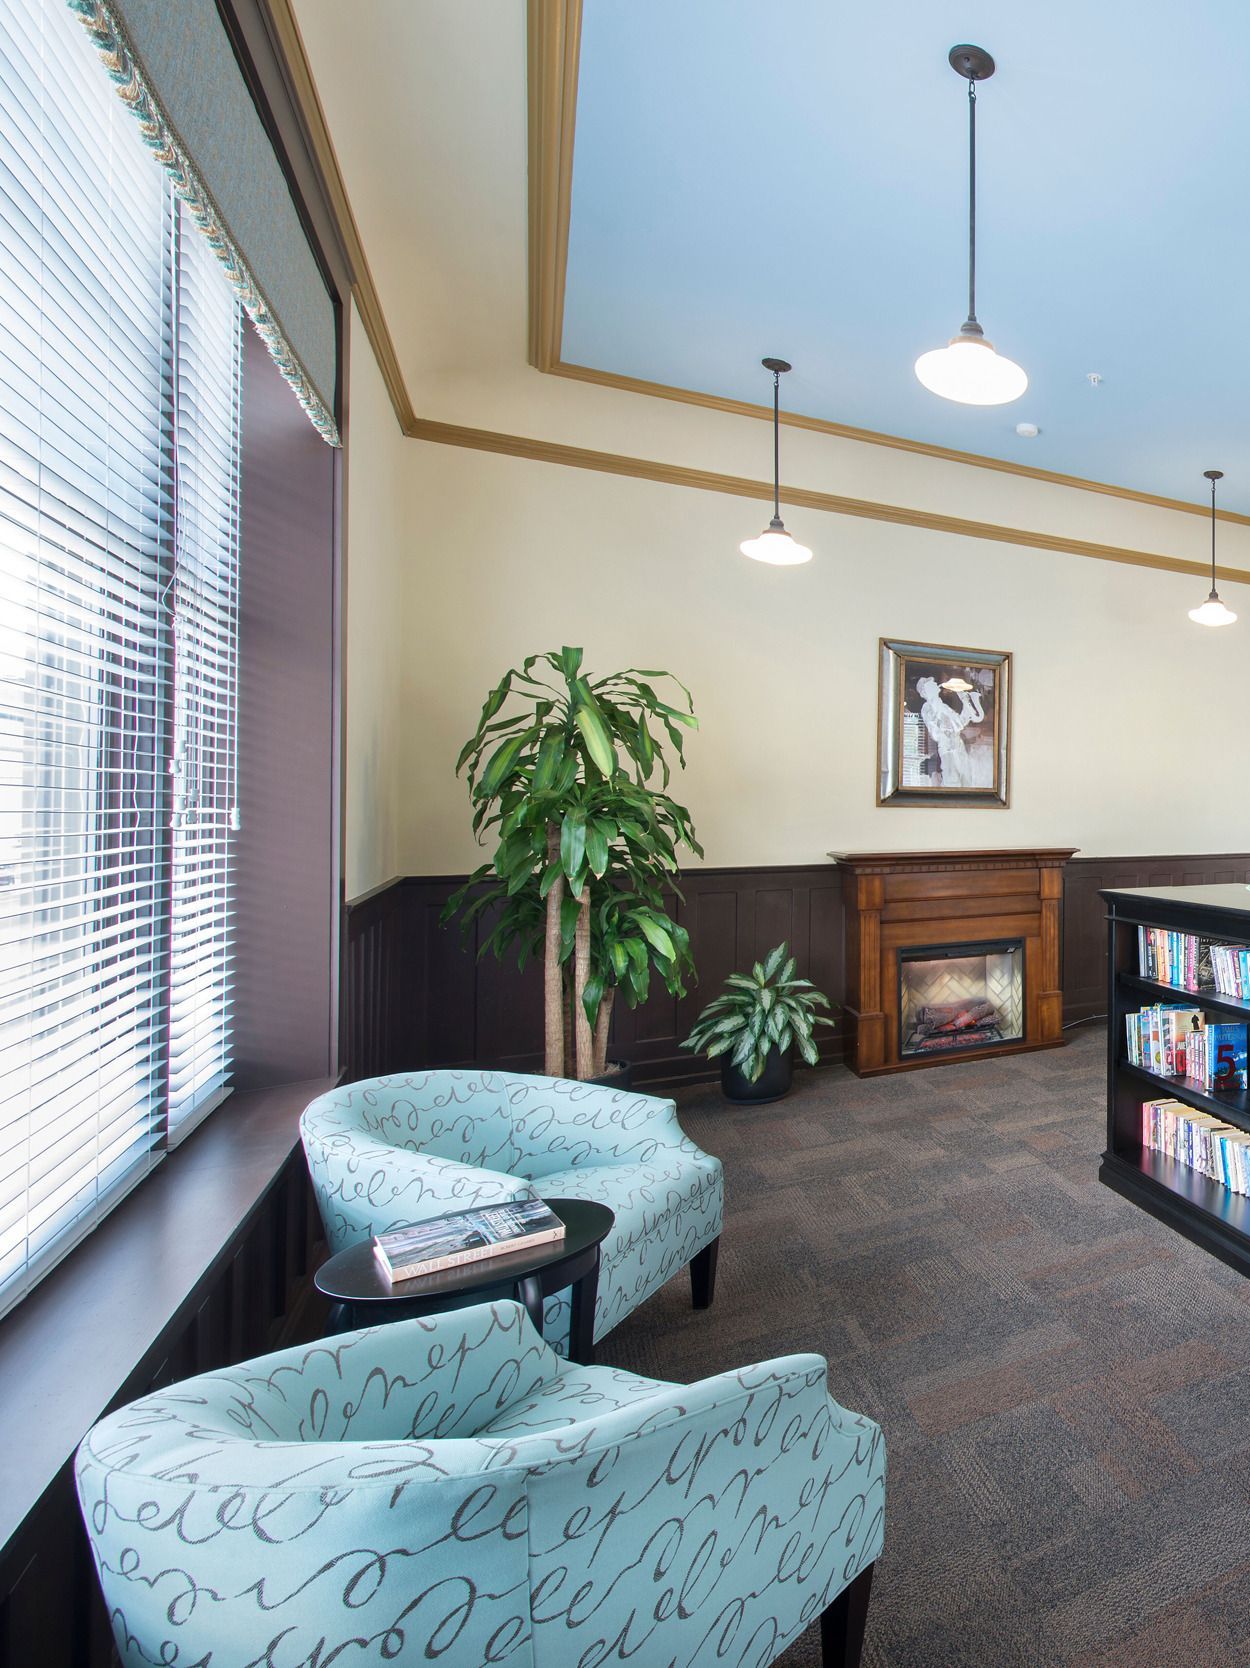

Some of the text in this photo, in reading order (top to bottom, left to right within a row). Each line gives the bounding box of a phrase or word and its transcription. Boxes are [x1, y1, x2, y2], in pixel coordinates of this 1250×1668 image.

[1217, 1044, 1236, 1080] 5
[404, 1259, 441, 1276] WALL
[448, 1246, 494, 1265] STREET
